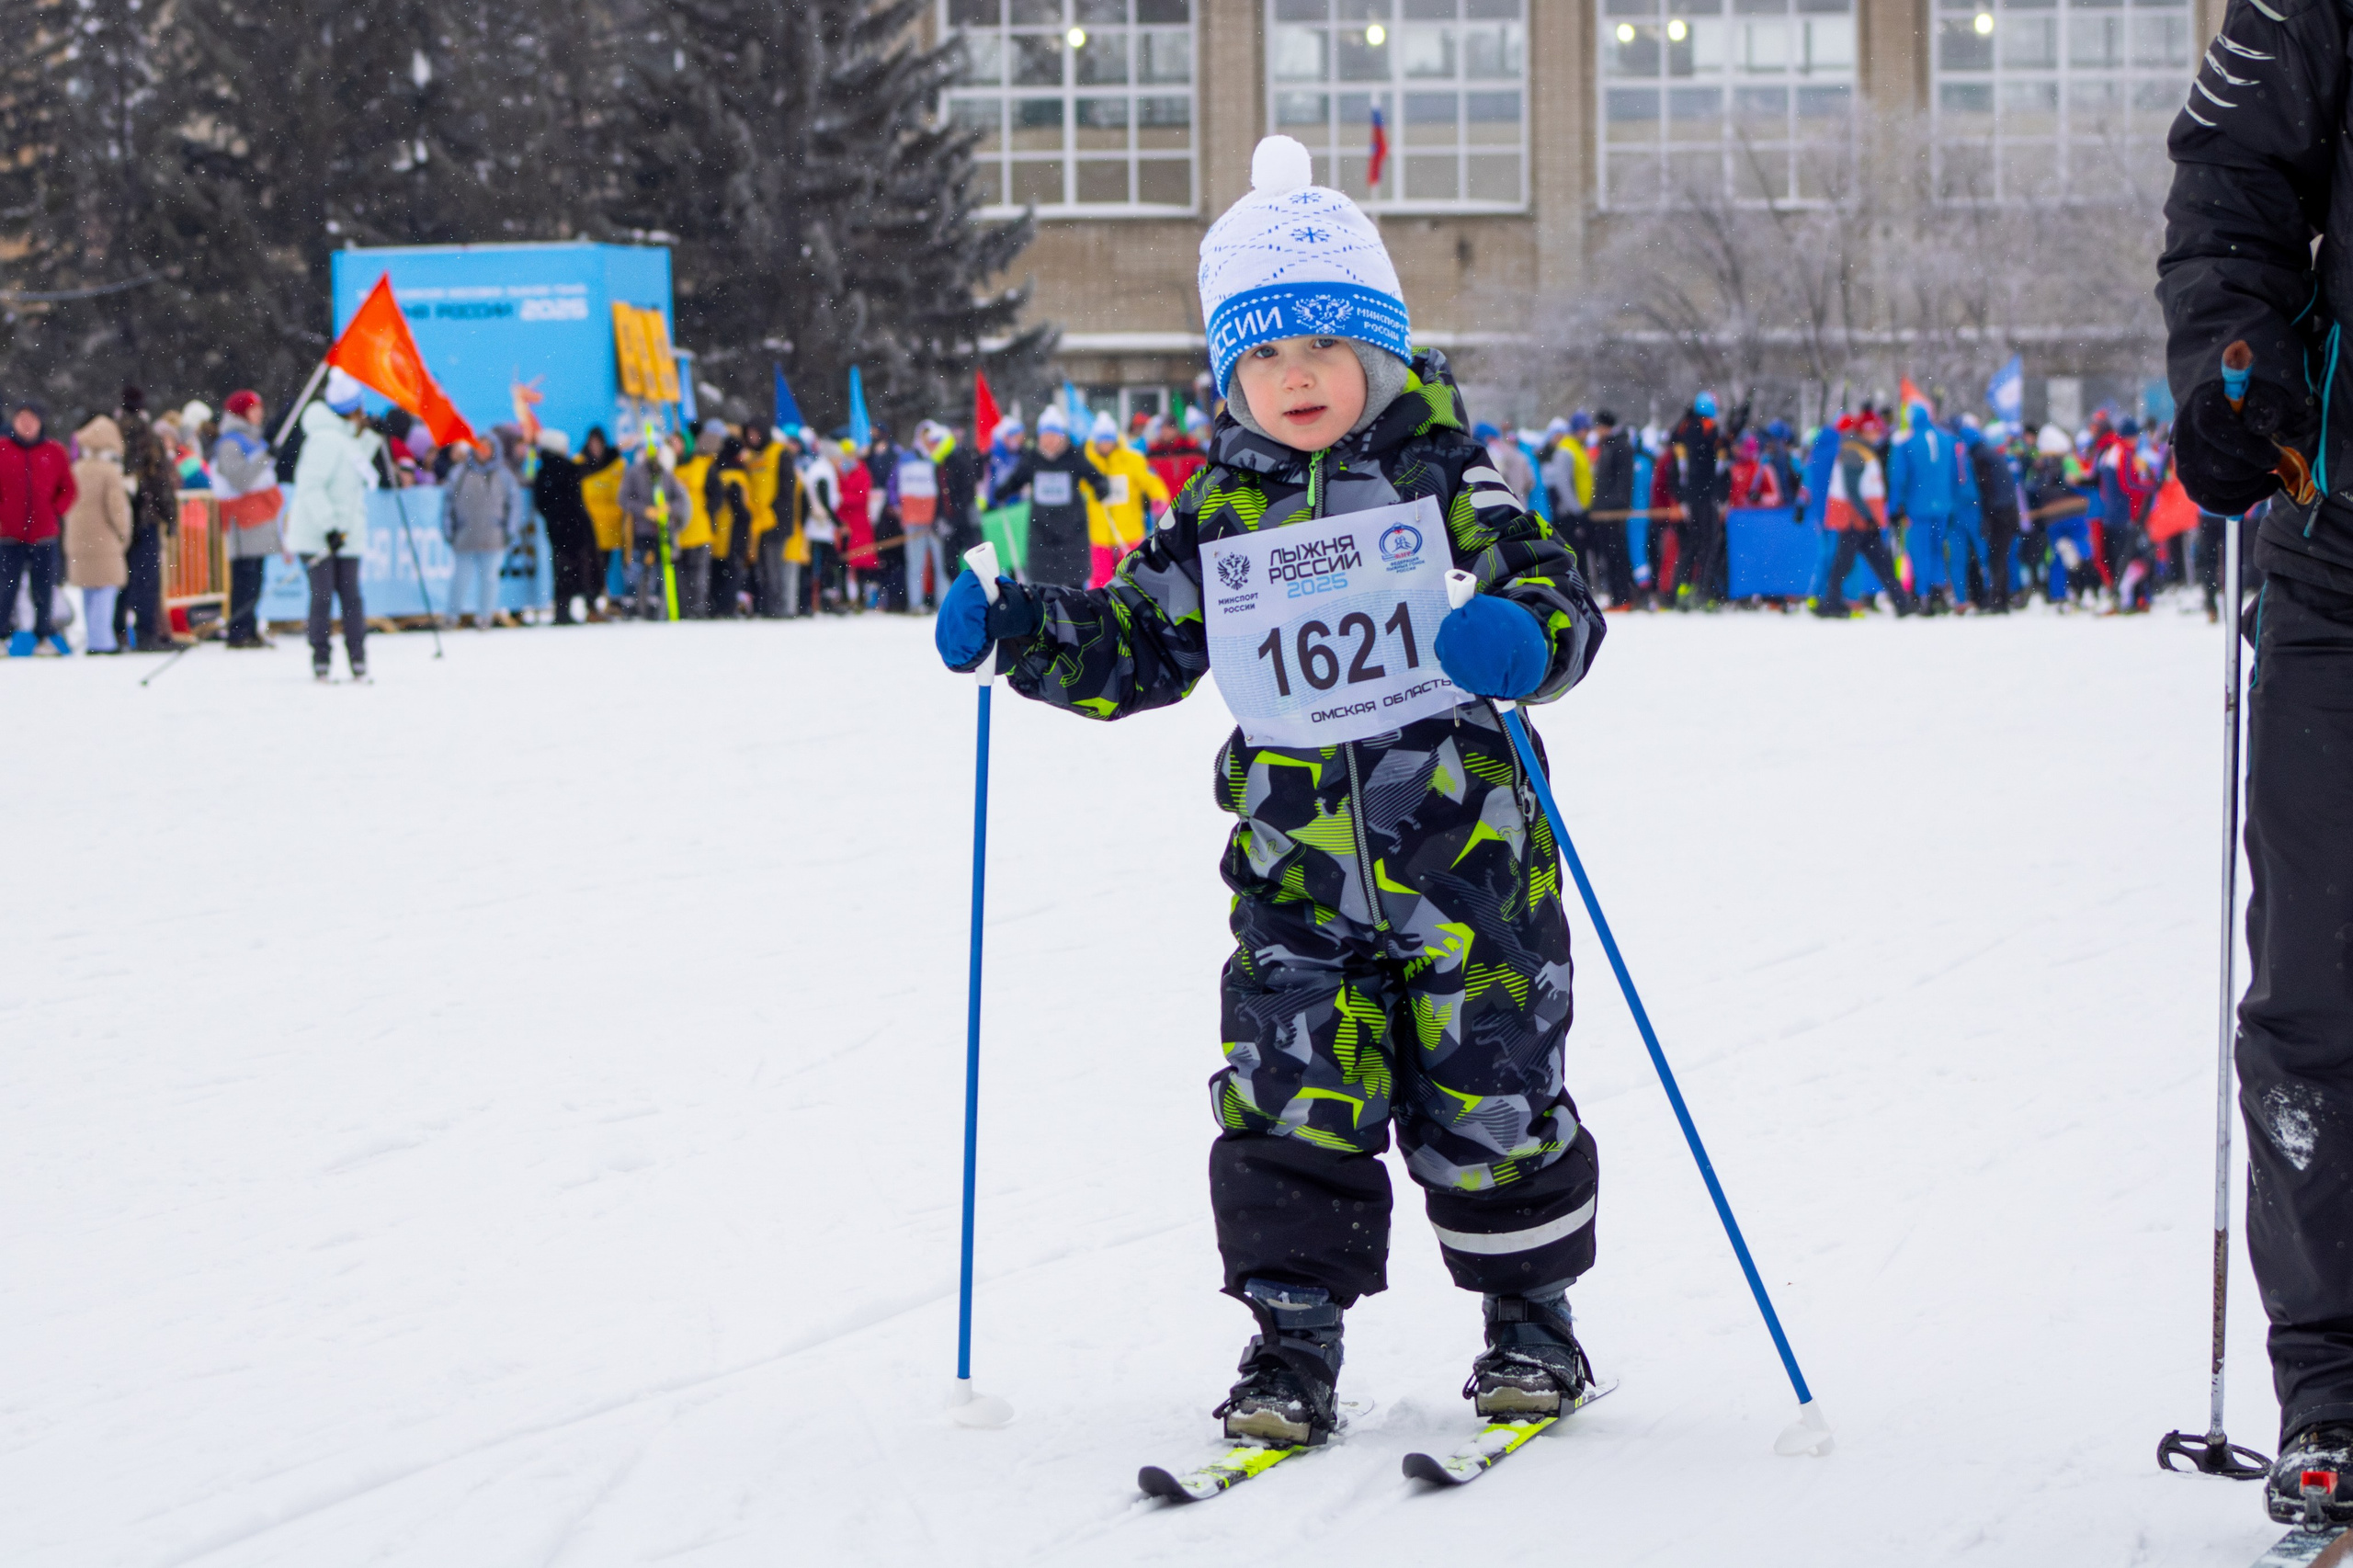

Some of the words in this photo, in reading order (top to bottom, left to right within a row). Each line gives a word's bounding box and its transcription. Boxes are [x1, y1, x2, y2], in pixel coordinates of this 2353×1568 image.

[1270, 534, 1355, 566] ЛЫЖНЯ
[1268, 551, 1362, 585] РОССИИ
[1218, 593, 1259, 606] МИНСПОРТ
[1287, 573, 1348, 598] 2025
[1223, 603, 1256, 614] РОССИИ
[1257, 601, 1419, 697] 1621
[1311, 700, 1377, 723] ОМСКАЯ
[1382, 678, 1452, 707] ОБЛАСТЬ
